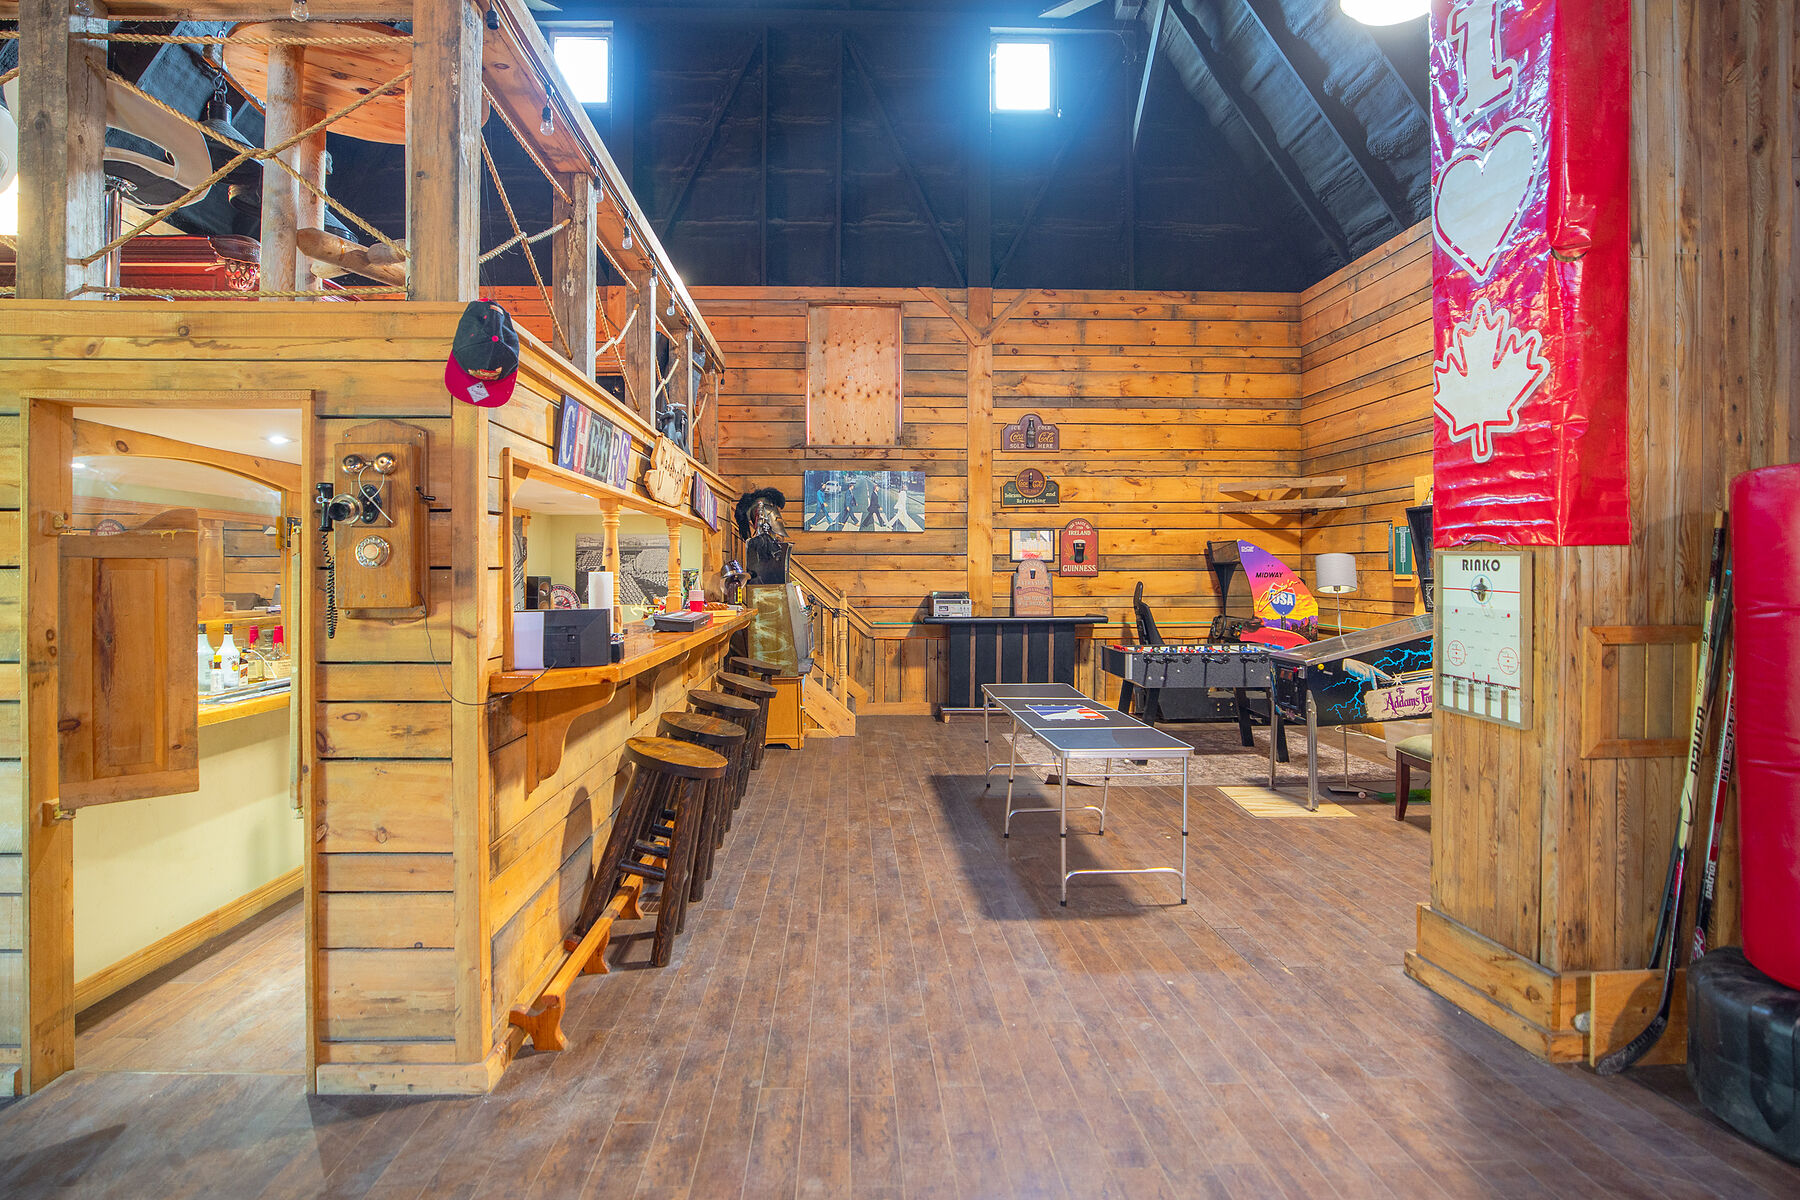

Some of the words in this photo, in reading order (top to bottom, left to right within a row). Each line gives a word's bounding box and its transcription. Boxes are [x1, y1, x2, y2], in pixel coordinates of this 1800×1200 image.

[1009, 431, 1026, 443] Coca
[1038, 431, 1055, 443] Cola
[562, 404, 631, 487] CHEERS
[1062, 564, 1097, 572] GUINNESS
[1462, 559, 1501, 572] RINKO
[1272, 591, 1294, 606] USA
[1381, 691, 1420, 715] Addams
[1705, 860, 1717, 900] patriot
